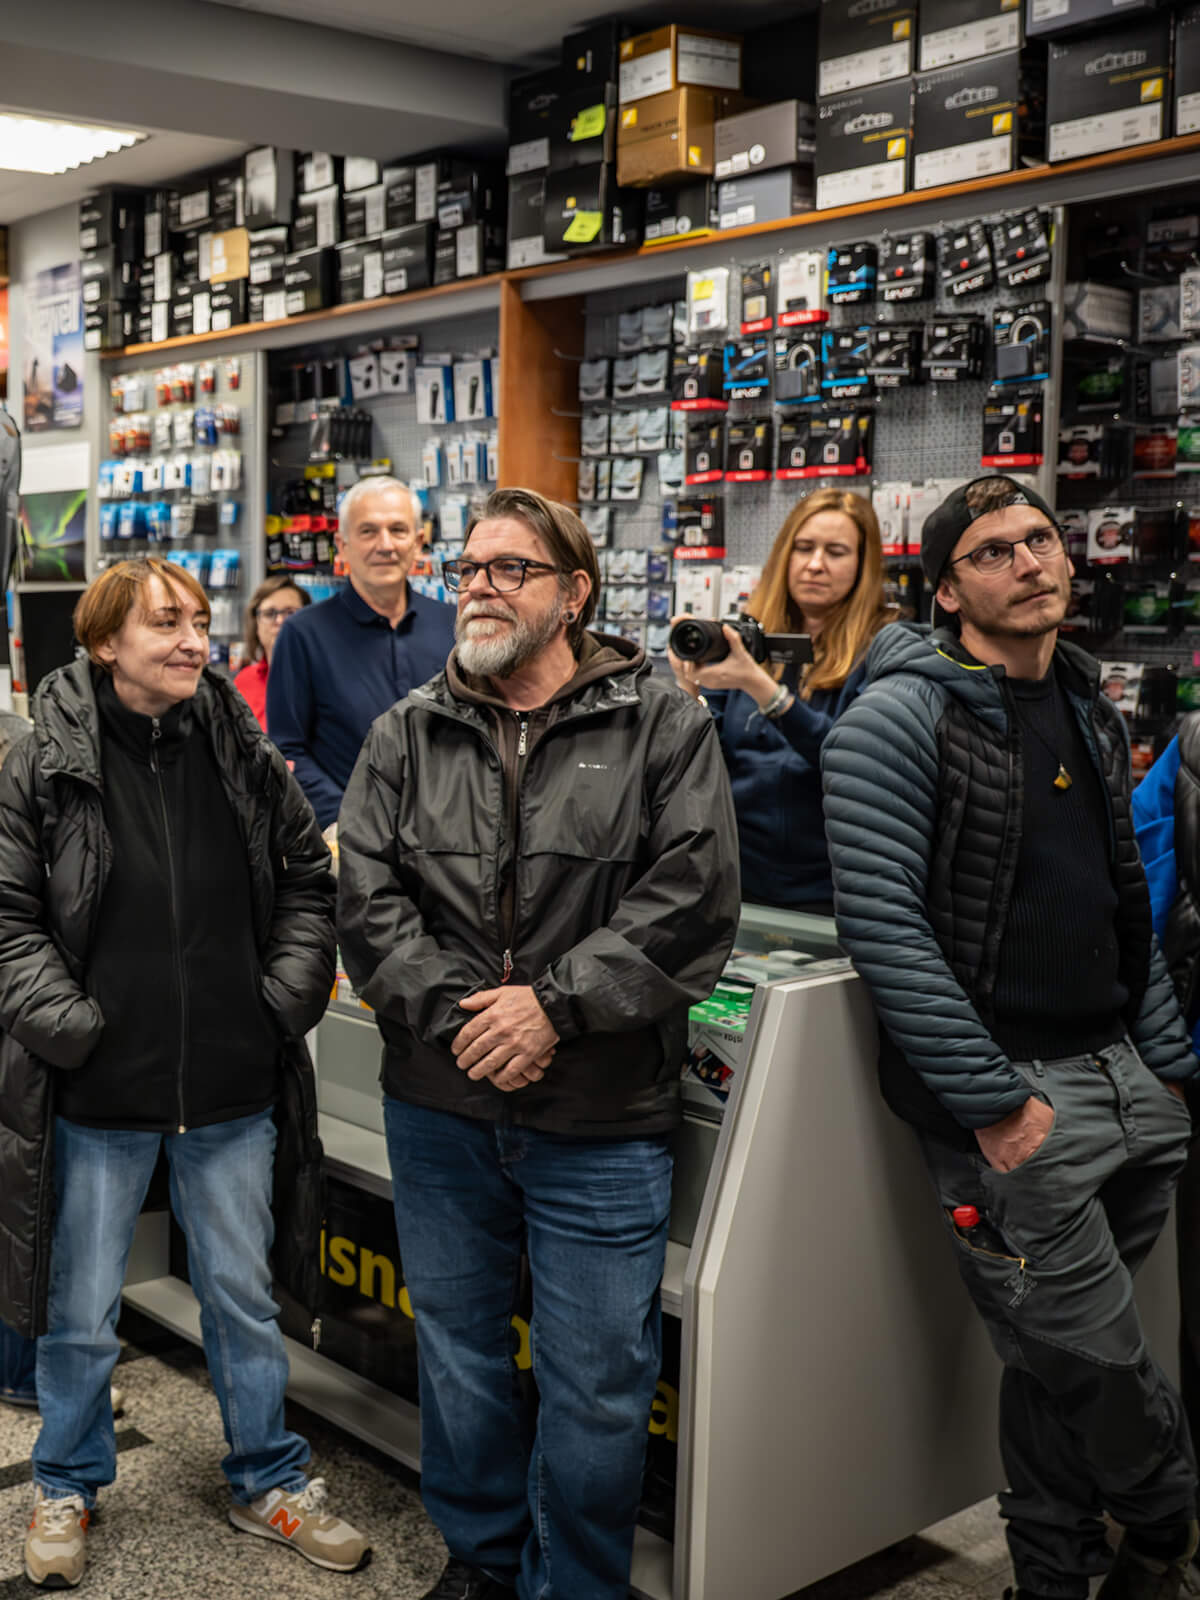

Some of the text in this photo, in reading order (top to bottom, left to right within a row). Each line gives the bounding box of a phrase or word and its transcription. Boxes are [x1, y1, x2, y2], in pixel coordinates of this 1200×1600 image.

[1007, 264, 1043, 286] Lexar
[883, 285, 917, 302] Lexar
[952, 274, 986, 296] Lexar
[831, 384, 862, 399] Lexar
